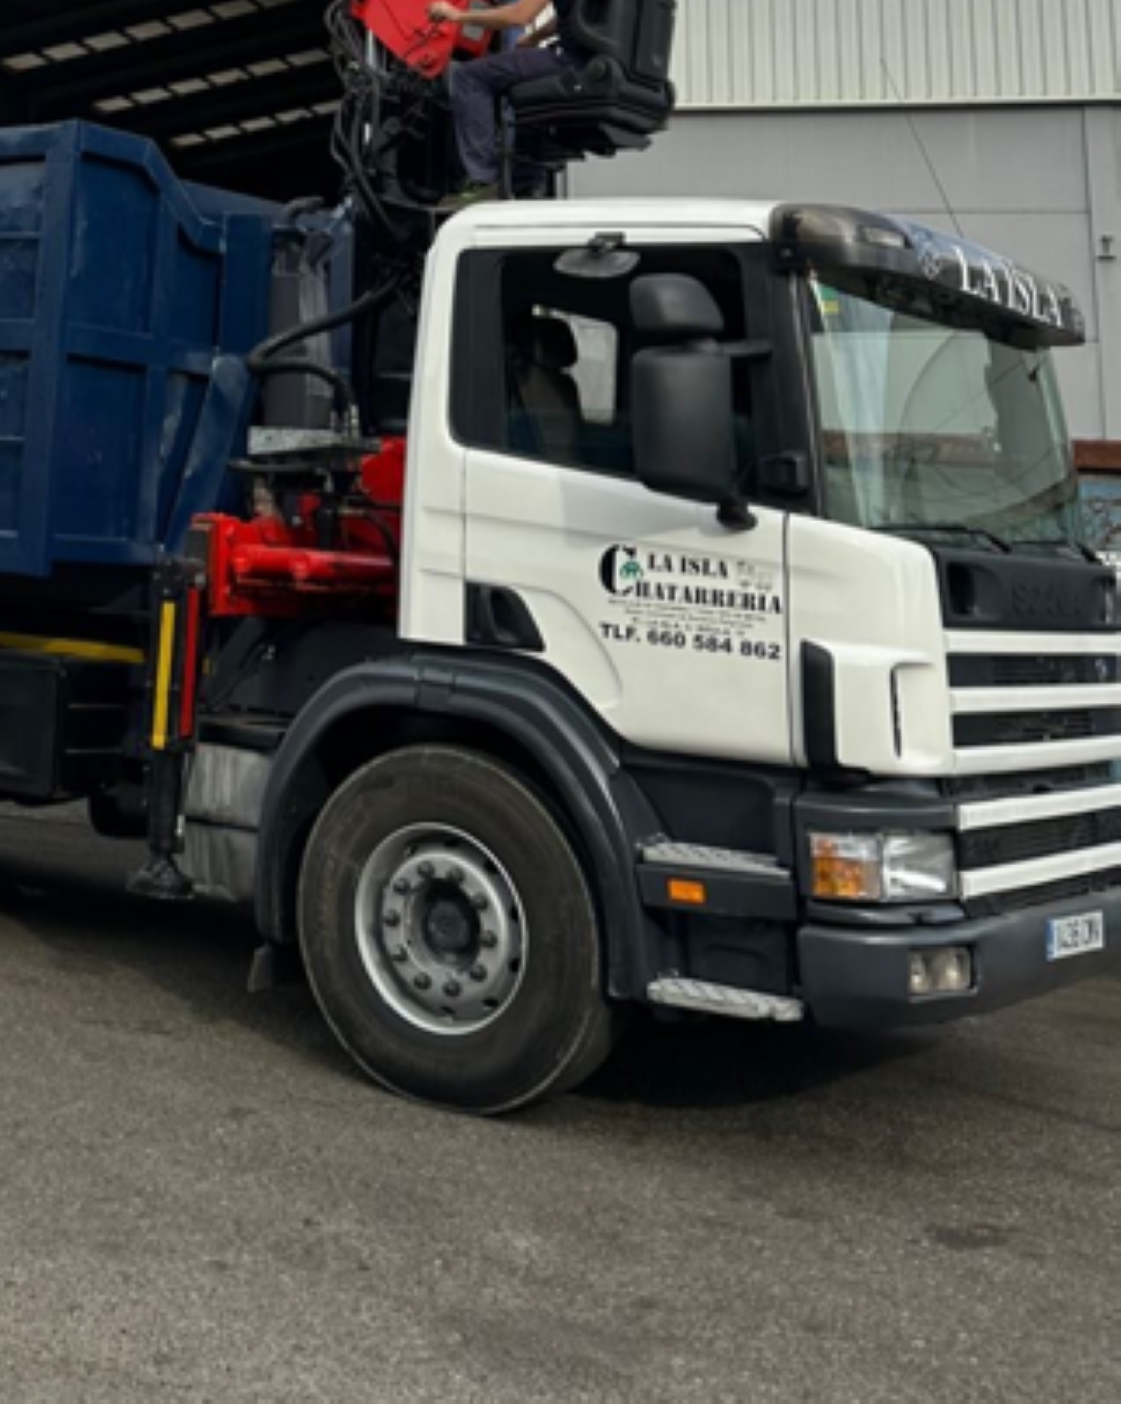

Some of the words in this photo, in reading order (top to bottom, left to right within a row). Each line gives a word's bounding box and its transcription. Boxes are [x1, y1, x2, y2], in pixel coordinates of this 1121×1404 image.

[952, 245, 1001, 304] LA
[1000, 260, 1064, 329] ISLA
[598, 544, 782, 614] CHATARRERIA
[648, 553, 674, 574] LA
[680, 556, 729, 580] ISLA
[599, 621, 641, 643] TLF.
[647, 628, 686, 648] 660
[692, 633, 732, 654] 584
[740, 640, 782, 660] 862
